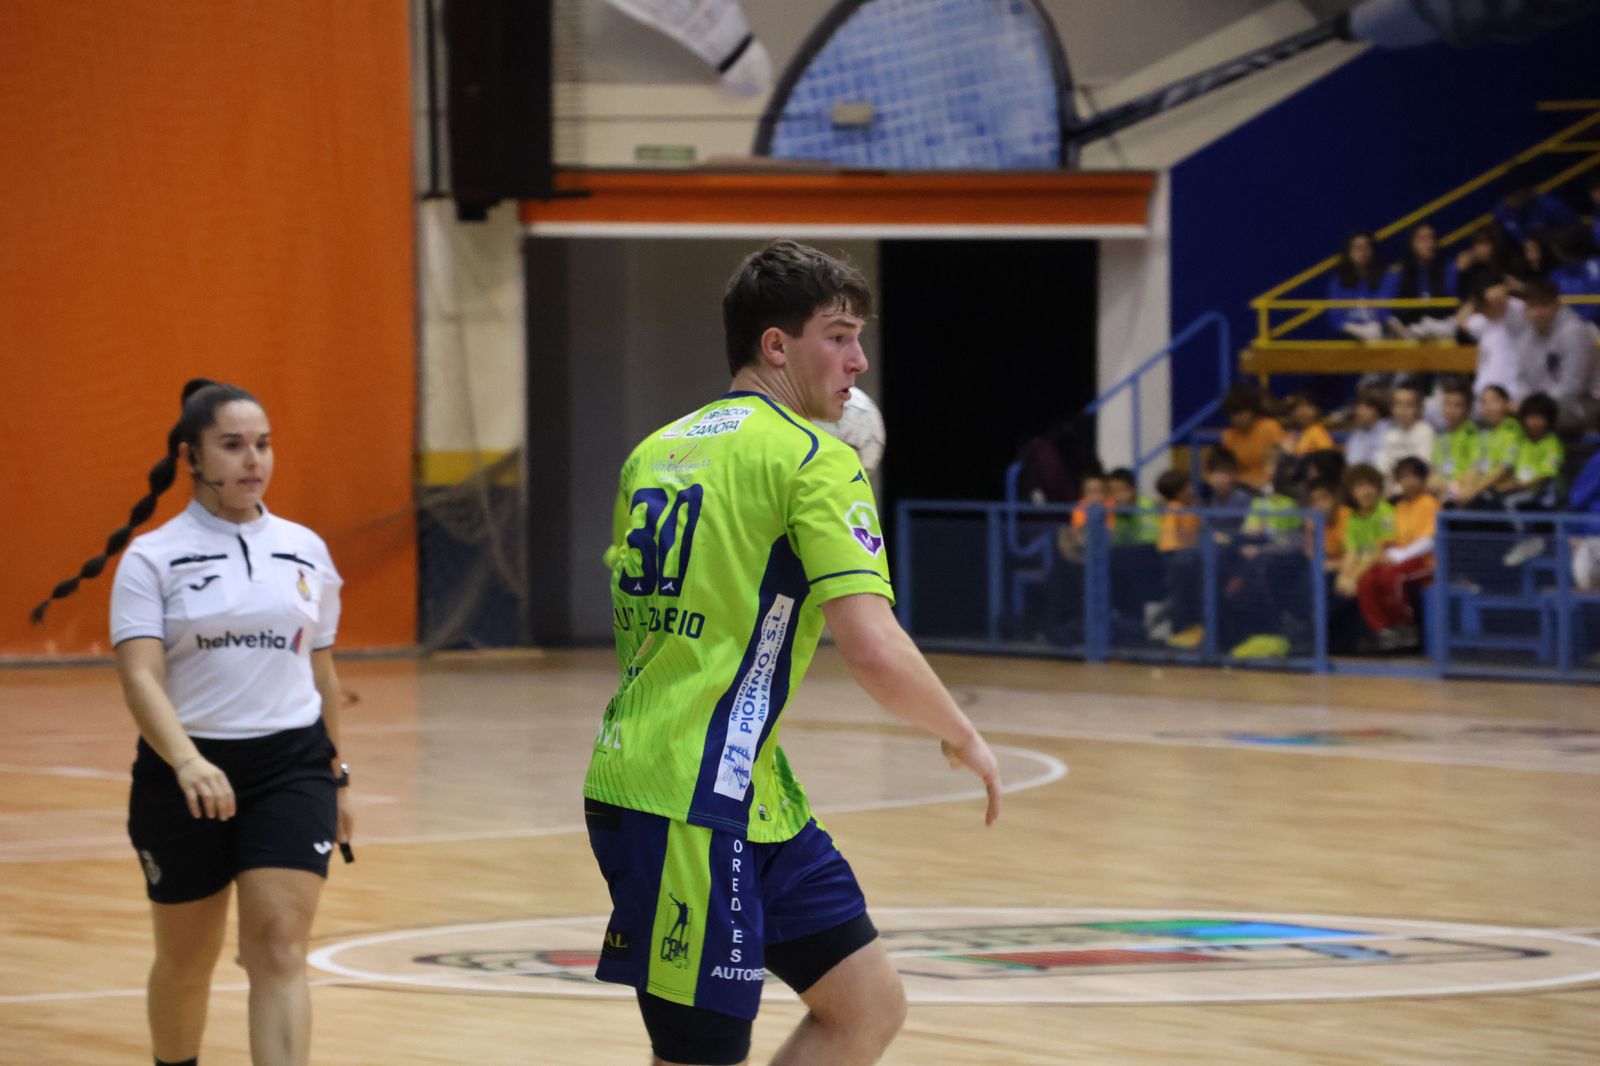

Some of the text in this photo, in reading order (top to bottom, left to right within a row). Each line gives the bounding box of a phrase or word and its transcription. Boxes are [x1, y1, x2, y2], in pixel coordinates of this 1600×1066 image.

[686, 419, 740, 437] ZAMORA
[618, 483, 704, 597] 30
[196, 629, 287, 650] helvetia
[761, 668, 773, 692] Baja
[760, 694, 769, 703] y
[758, 703, 769, 722] Alta
